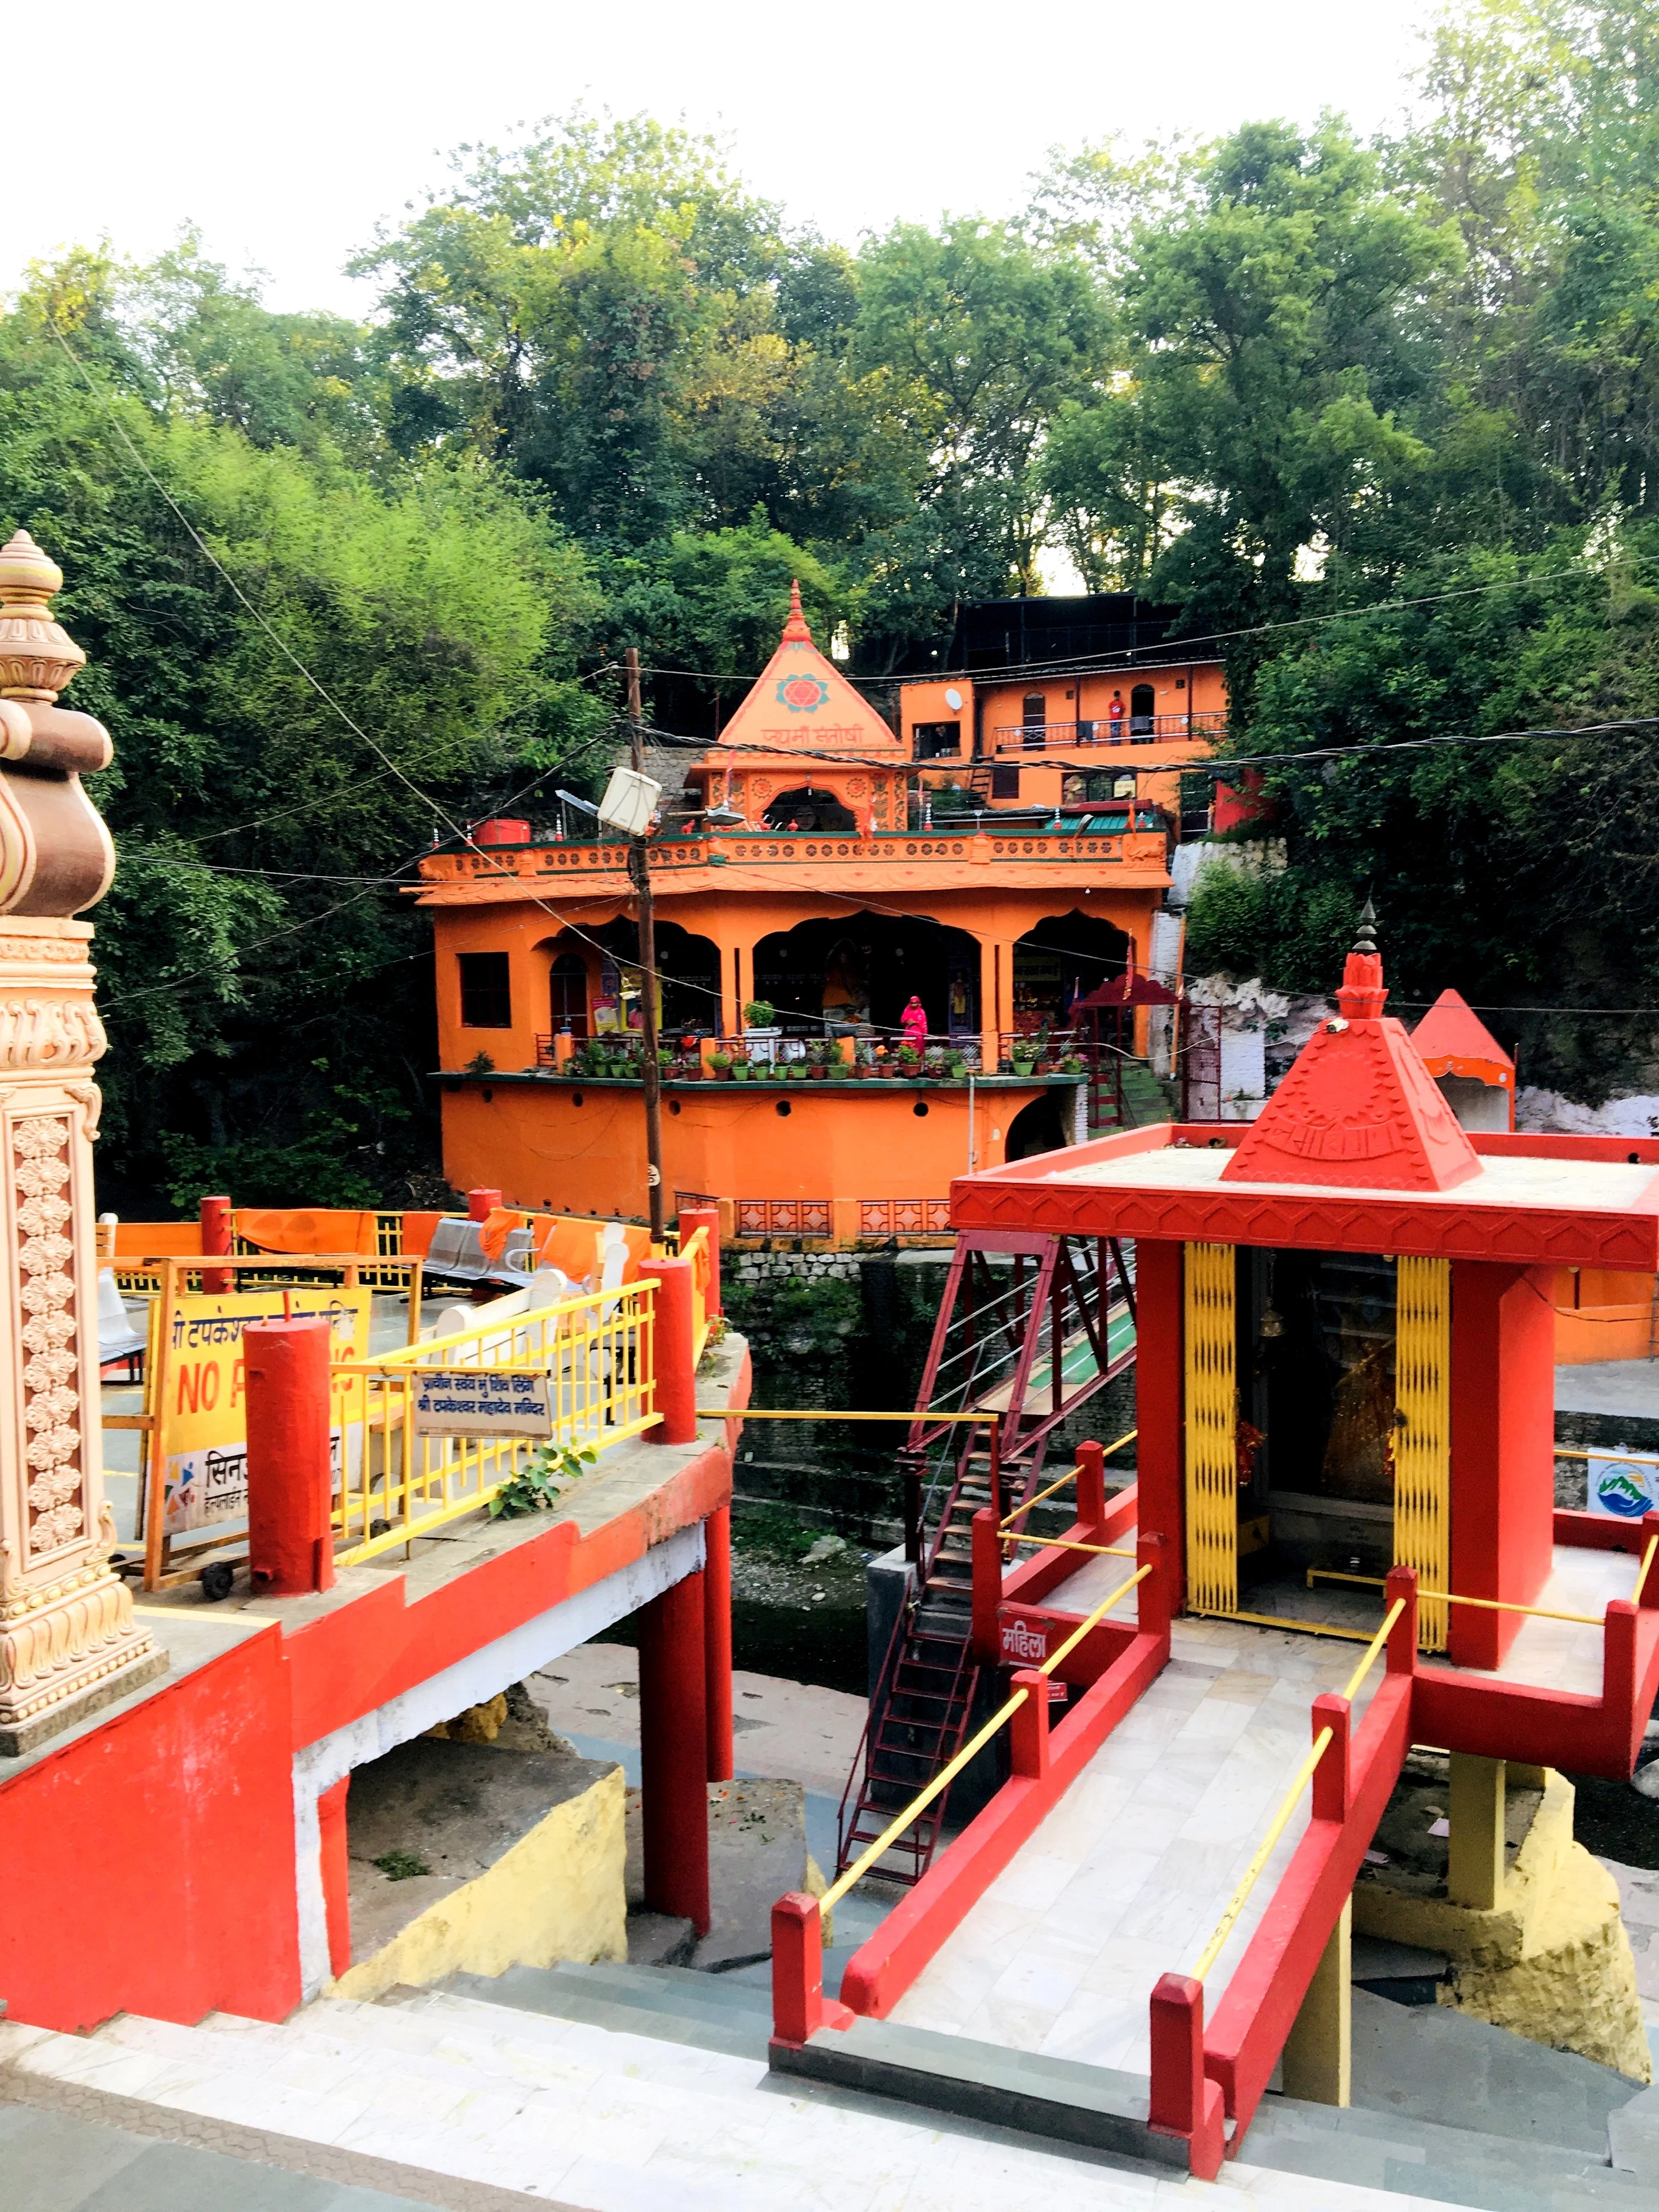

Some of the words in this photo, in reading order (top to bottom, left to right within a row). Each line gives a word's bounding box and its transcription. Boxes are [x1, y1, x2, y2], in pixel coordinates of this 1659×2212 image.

[177, 1361, 219, 1415] NO
[418, 1394, 431, 1412] श्री
[433, 1395, 476, 1413] टपकेश्वर
[477, 1397, 512, 1416] महादेव
[1002, 1620, 1046, 1658] महिला
